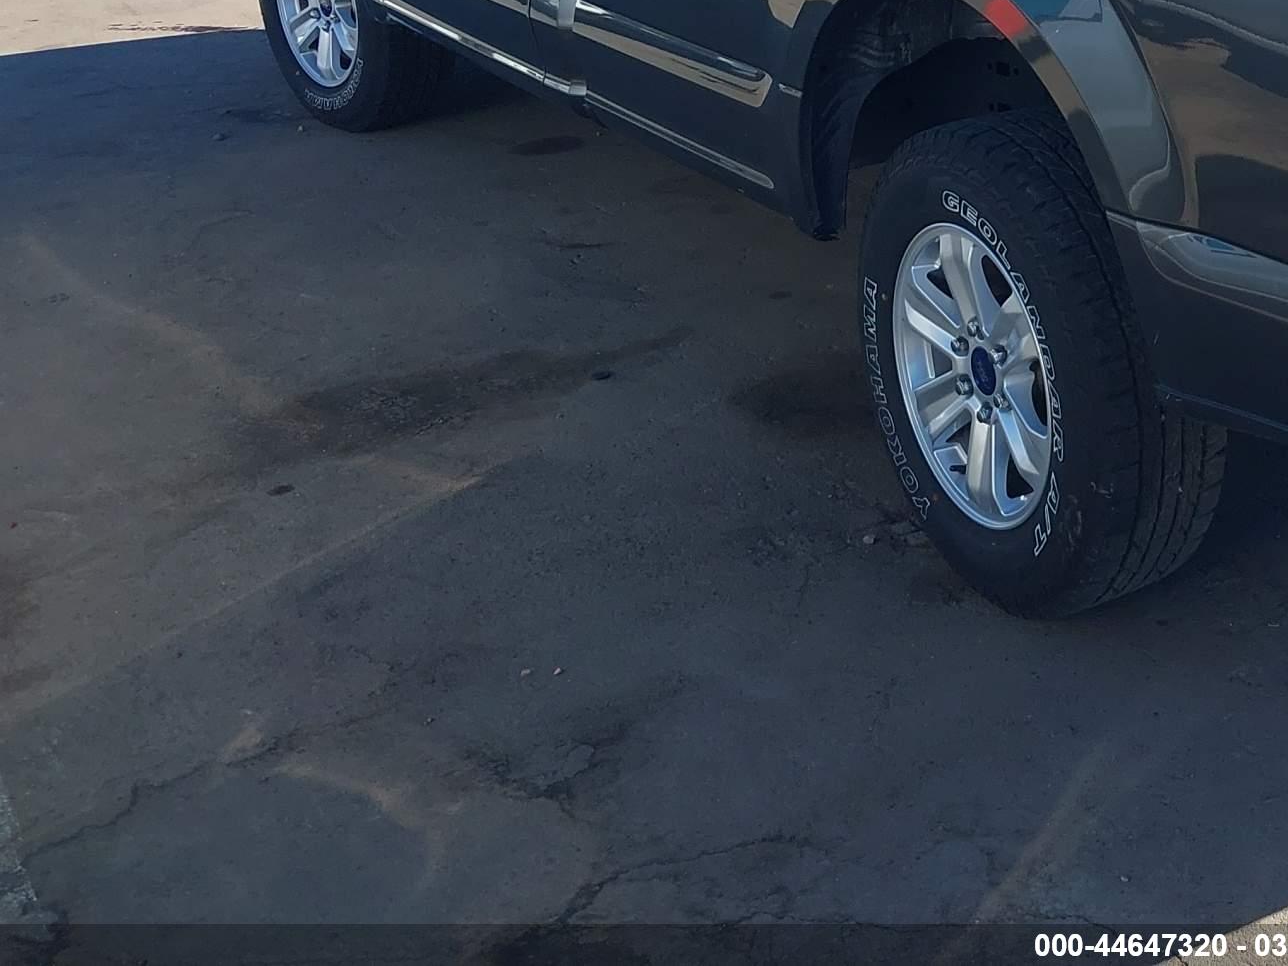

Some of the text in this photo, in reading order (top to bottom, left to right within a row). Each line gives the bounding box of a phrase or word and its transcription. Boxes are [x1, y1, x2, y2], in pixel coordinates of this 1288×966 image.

[862, 276, 928, 522] YOKOHAMA
[941, 189, 1064, 557] GEOLANDAR A/T
